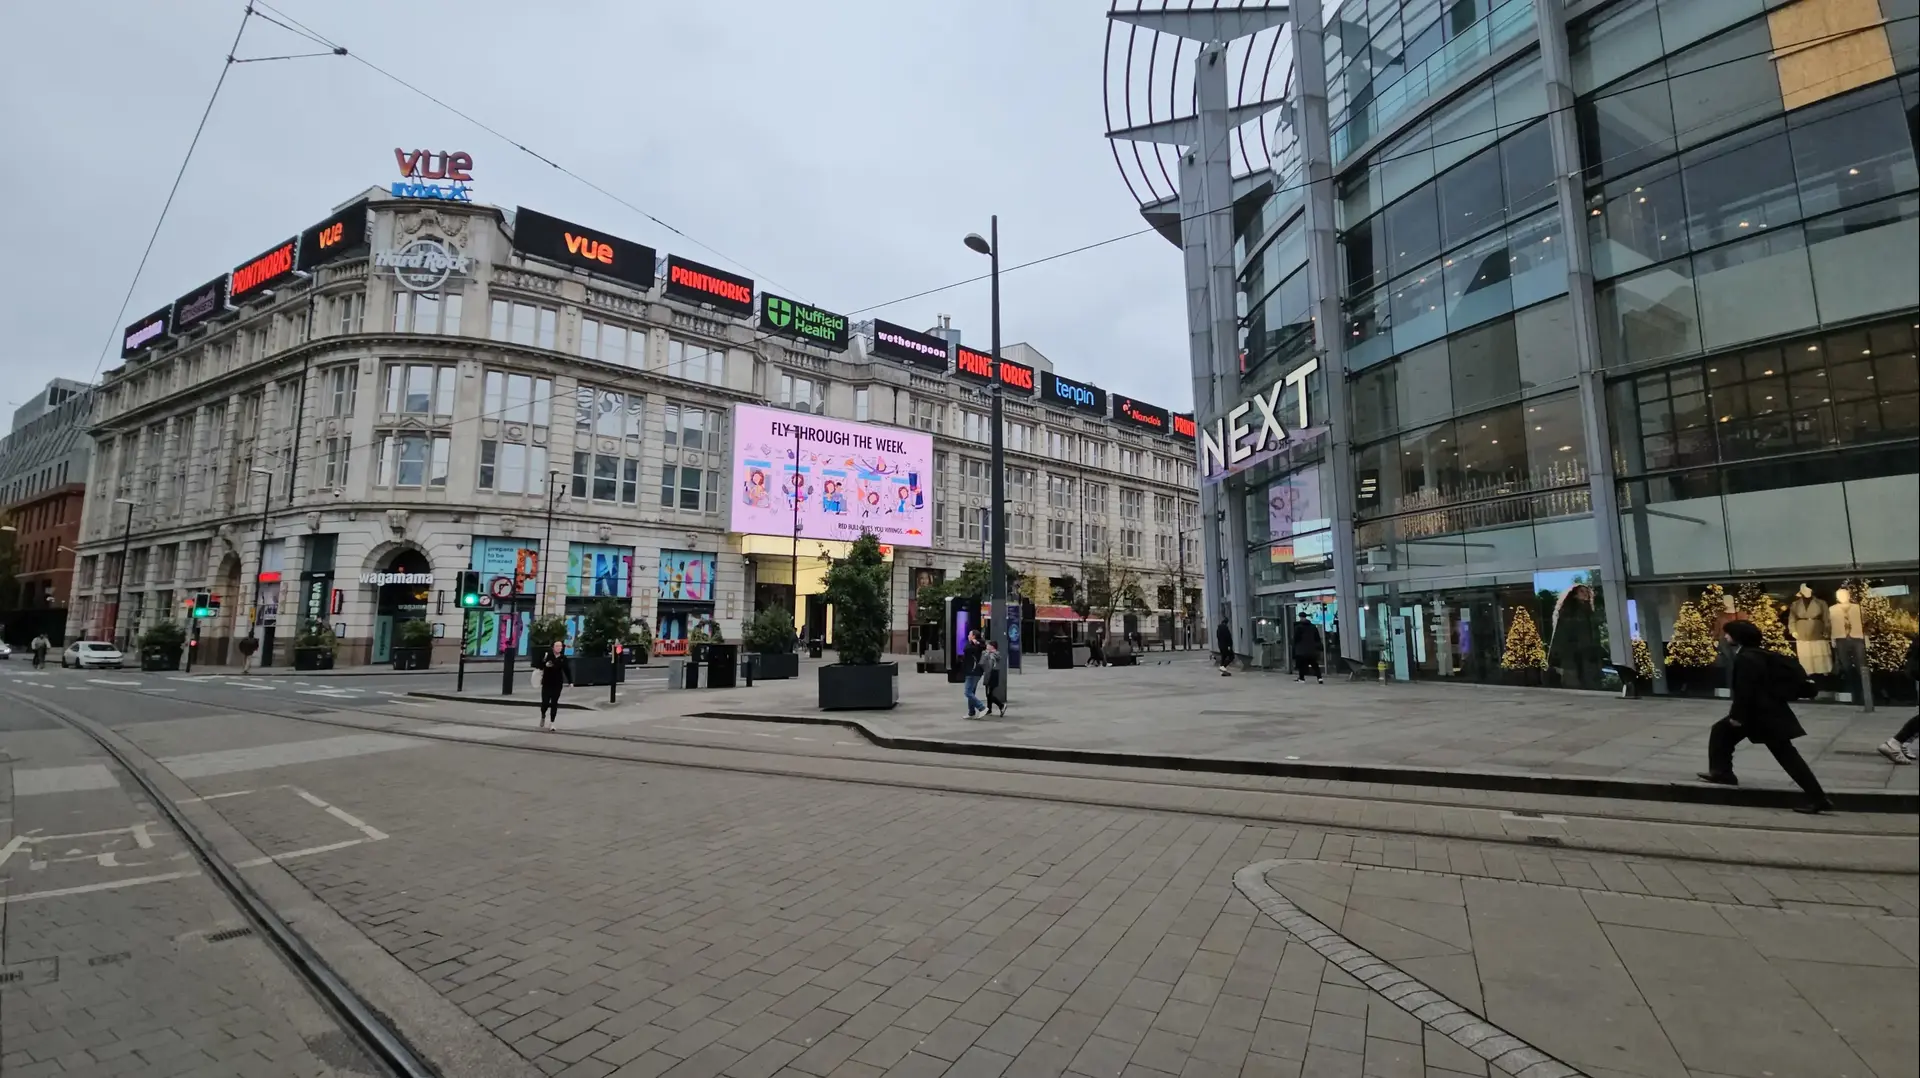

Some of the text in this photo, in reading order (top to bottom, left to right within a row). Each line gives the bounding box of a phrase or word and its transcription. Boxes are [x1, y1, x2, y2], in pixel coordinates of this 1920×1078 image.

[394, 147, 474, 182] vue
[319, 221, 343, 250] vue
[564, 231, 614, 265] vue
[231, 243, 295, 297] PRINTWORKS
[671, 265, 751, 304] PRINTWORKS
[794, 318, 836, 342] Health
[795, 305, 844, 331] Nuffield
[878, 330, 946, 359] wetherspoon
[958, 349, 1033, 389] PRINTORKS
[1055, 377, 1094, 407] tenpin
[1131, 409, 1162, 428] Nando's
[1202, 357, 1319, 477] NEXT
[771, 421, 790, 438] FLY
[852, 434, 873, 450] THE
[876, 438, 907, 456] WEEK.
[359, 572, 434, 586] wagamama
